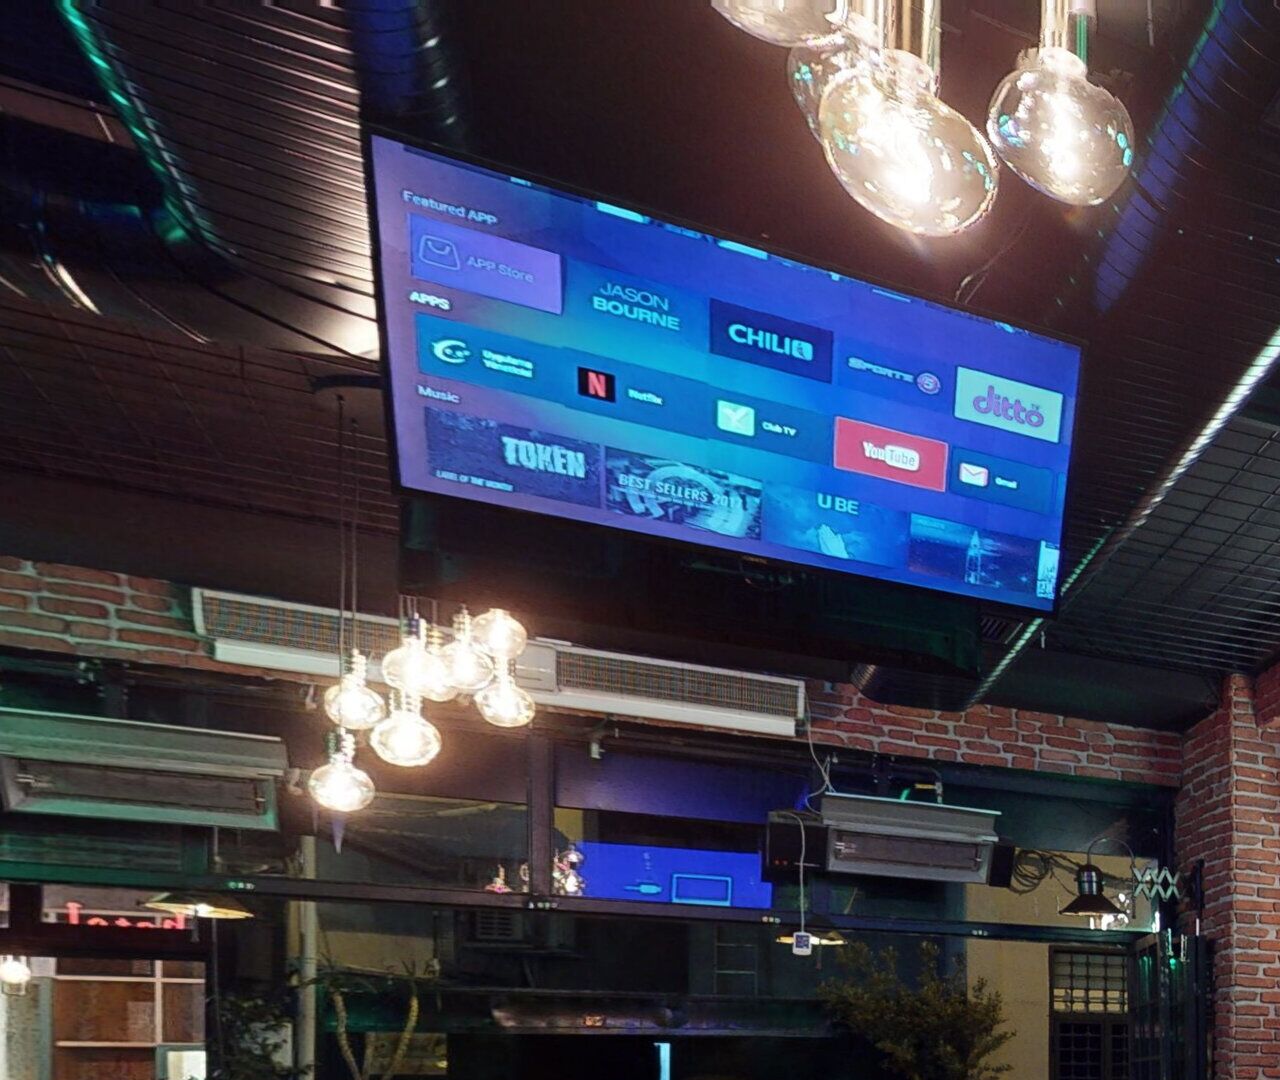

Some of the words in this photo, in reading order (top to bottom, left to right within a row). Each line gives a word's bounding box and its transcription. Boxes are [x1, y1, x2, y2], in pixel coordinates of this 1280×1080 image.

[403, 191, 465, 217] Featured
[467, 208, 498, 225] APP
[465, 255, 496, 271] APP
[497, 263, 534, 283] Store
[409, 290, 451, 310] APPS
[600, 282, 670, 312] JASON
[592, 296, 681, 331] BOURNE
[728, 323, 794, 356] CHILI
[417, 385, 461, 404] Music
[587, 371, 607, 398] N
[973, 384, 1045, 428] ditto
[783, 425, 797, 438] TV
[501, 436, 586, 479] TOKEN
[862, 440, 918, 468] YouTube
[618, 473, 651, 491] BEST
[656, 480, 709, 503] SELLERS
